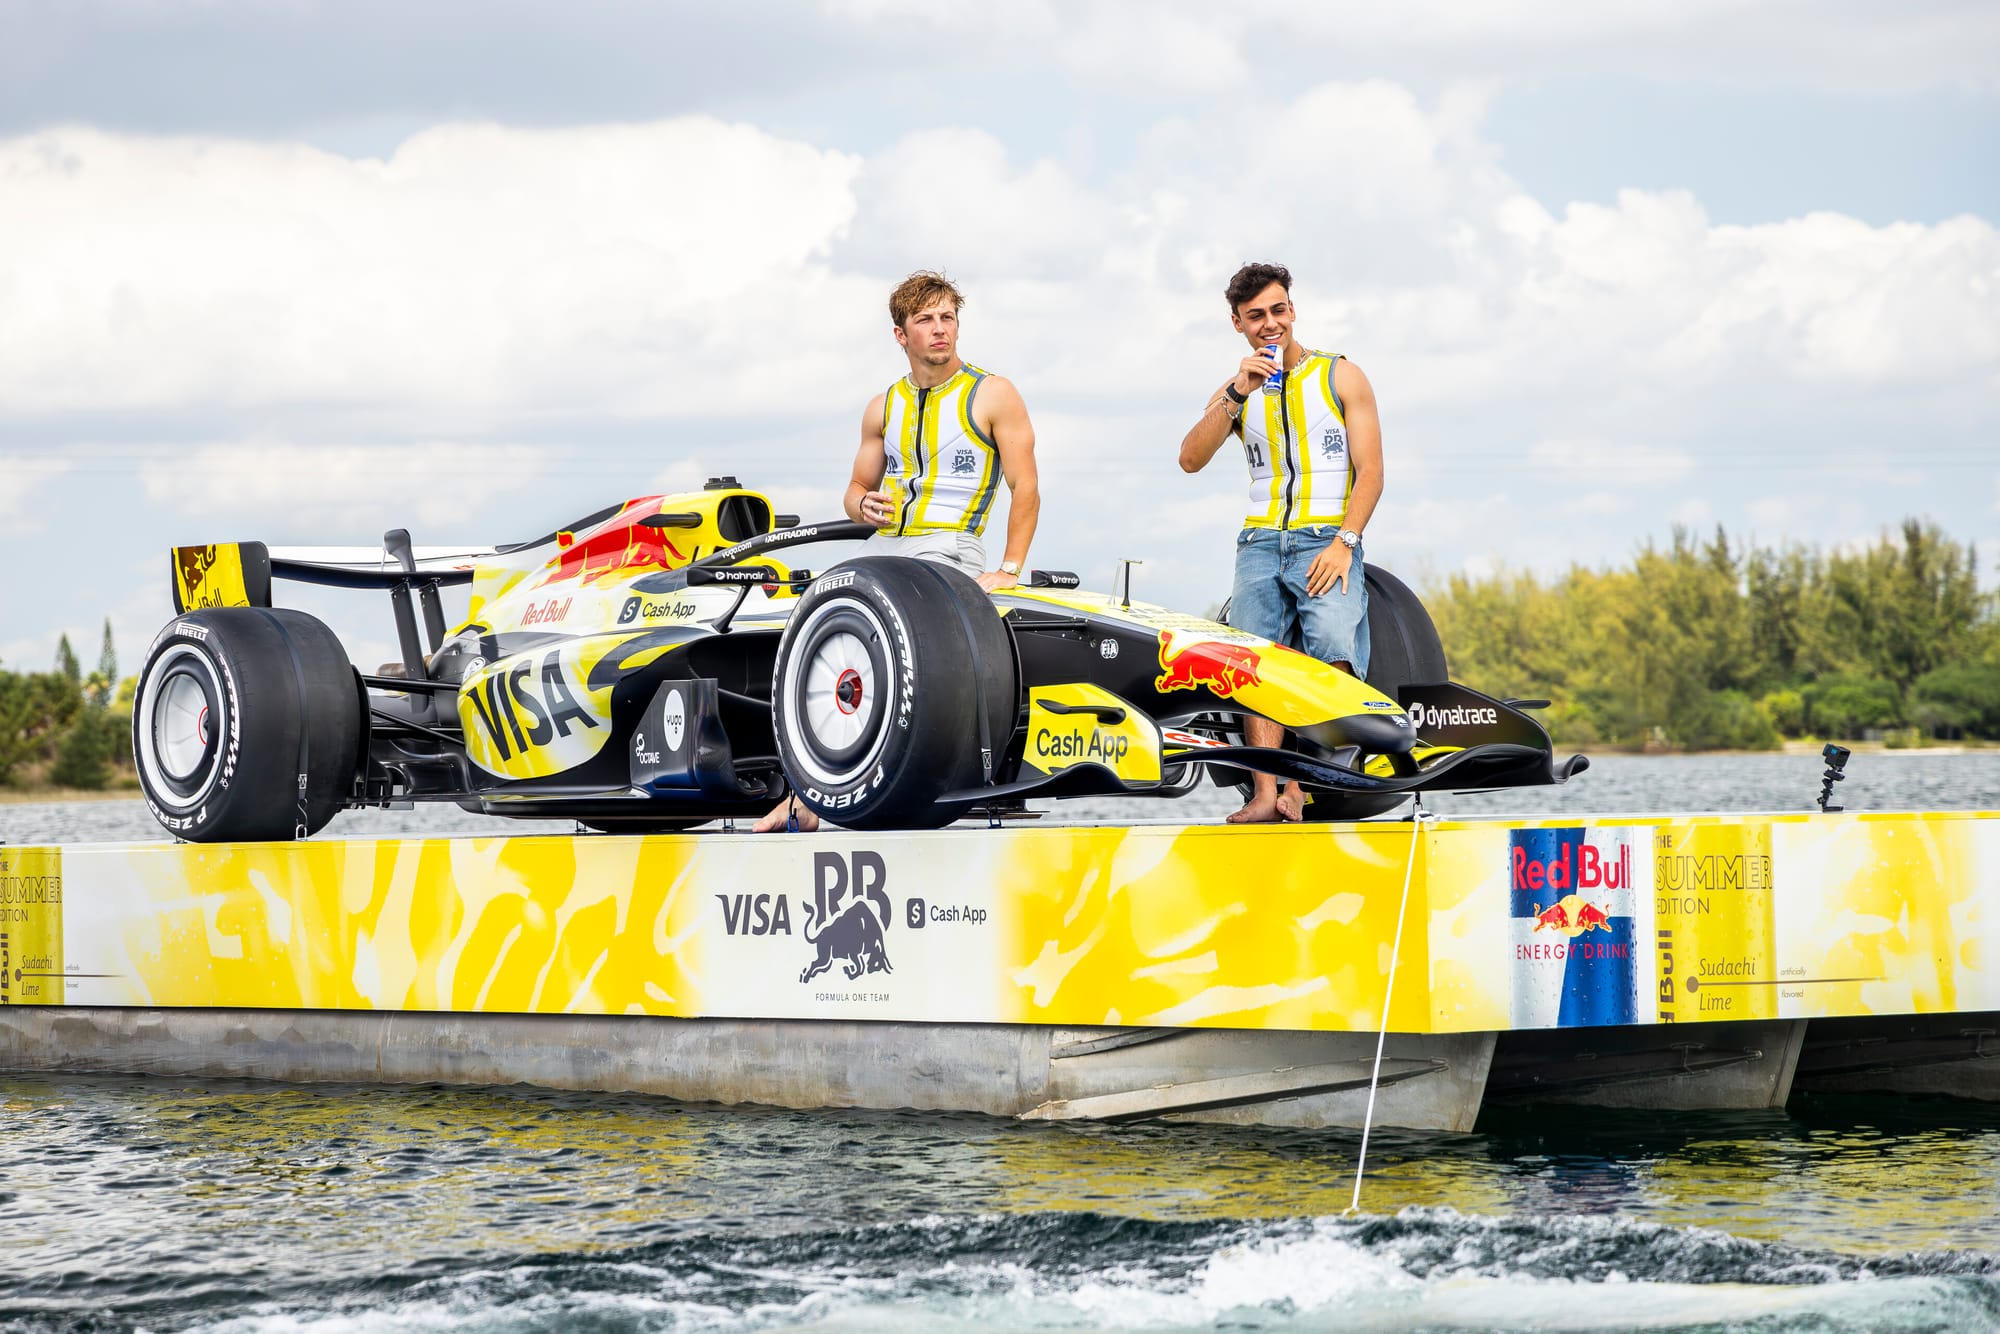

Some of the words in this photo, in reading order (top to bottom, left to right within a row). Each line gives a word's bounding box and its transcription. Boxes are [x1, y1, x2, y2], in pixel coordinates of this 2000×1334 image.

[726, 571, 765, 581] hahnair
[815, 571, 857, 596] PIRELLI
[520, 600, 547, 627] Red
[544, 597, 573, 623] Bull
[642, 601, 671, 618] Cash
[671, 601, 697, 619] App
[174, 621, 209, 642] PIRELLI
[466, 650, 600, 762] VISA
[1426, 704, 1498, 730] dynatrace
[1036, 727, 1084, 757] Cash
[1087, 727, 1129, 764] App
[639, 751, 661, 764] OCTAVE
[872, 763, 885, 789] P
[805, 783, 868, 809] ZERO
[148, 799, 193, 830] ZERO
[196, 805, 208, 825] P
[1655, 835, 1673, 849] THE
[1512, 841, 1571, 891] Red
[1577, 843, 1631, 890] Bull
[1656, 855, 1773, 891] SUMMER
[715, 893, 793, 936] VISA
[929, 904, 961, 923] Cash
[962, 904, 988, 926] App
[1657, 898, 1710, 915] EDITION
[21, 954, 53, 969] Sudachi
[1516, 943, 1578, 960] ENERGY
[1584, 943, 1630, 960] DRINK
[1698, 957, 1756, 977] Sudachi
[21, 982, 40, 996] Lime
[815, 993, 850, 1002] FORMULA
[852, 993, 868, 1002] ONE
[870, 993, 890, 1002] TEAM
[1699, 992, 1732, 1011] Lime
